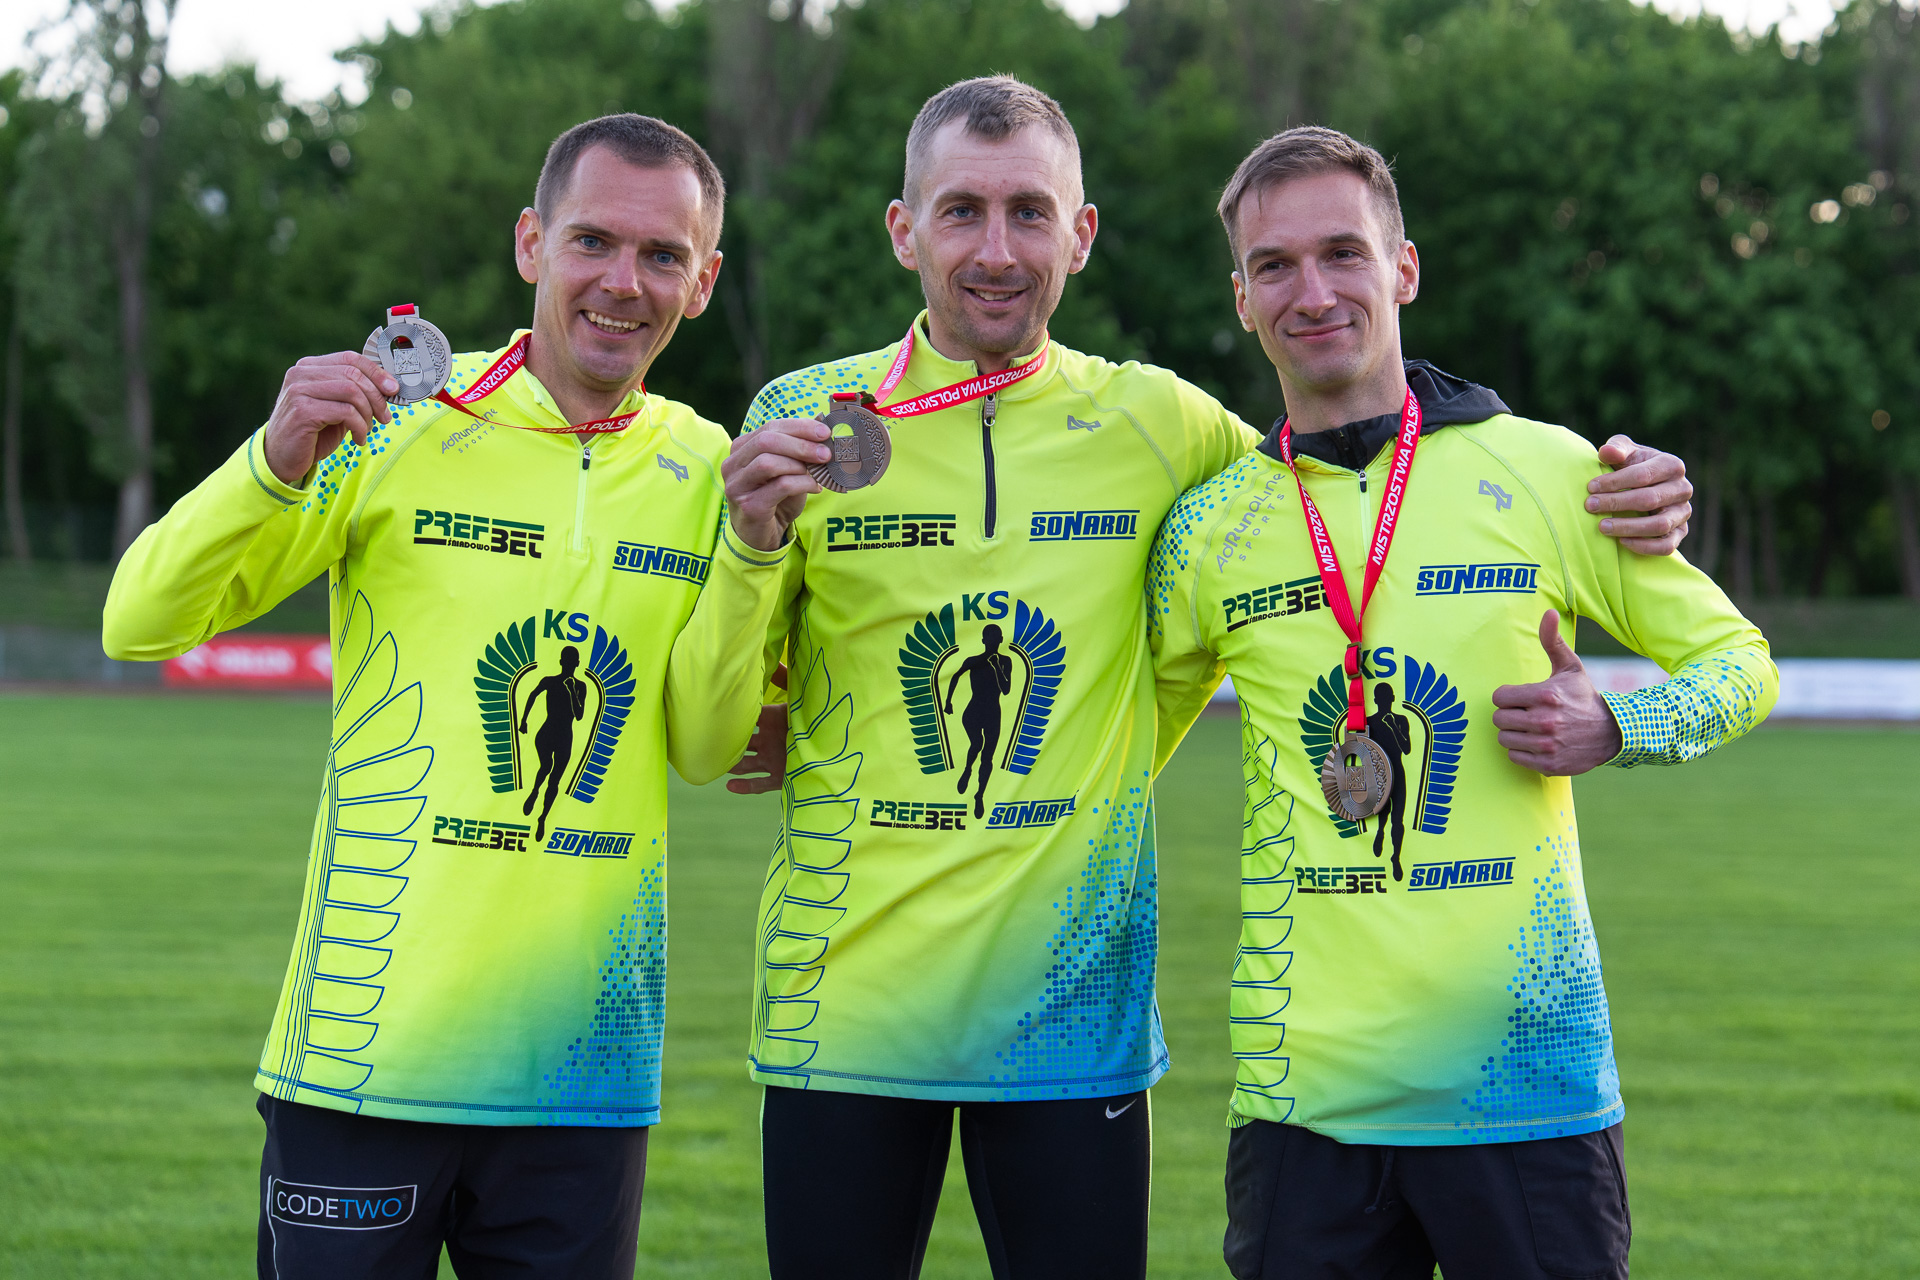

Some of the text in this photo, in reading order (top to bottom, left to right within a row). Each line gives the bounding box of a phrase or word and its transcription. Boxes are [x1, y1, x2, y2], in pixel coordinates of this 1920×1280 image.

[890, 356, 1043, 416] MISTRZOSTWA POLSKI 2025
[458, 425, 496, 454] SPORTS
[1372, 448, 1412, 566] MISTRZOSTWA
[1030, 510, 1140, 541] SONAROL
[1238, 493, 1285, 562] SPORTS
[613, 542, 709, 584] SONAROL
[1416, 564, 1540, 596] SONAROL
[962, 590, 1009, 621] KS
[543, 608, 589, 643] KS
[545, 828, 635, 858] SONAROL
[1409, 857, 1515, 891] SONAROL
[277, 1191, 402, 1219] CODETWO
